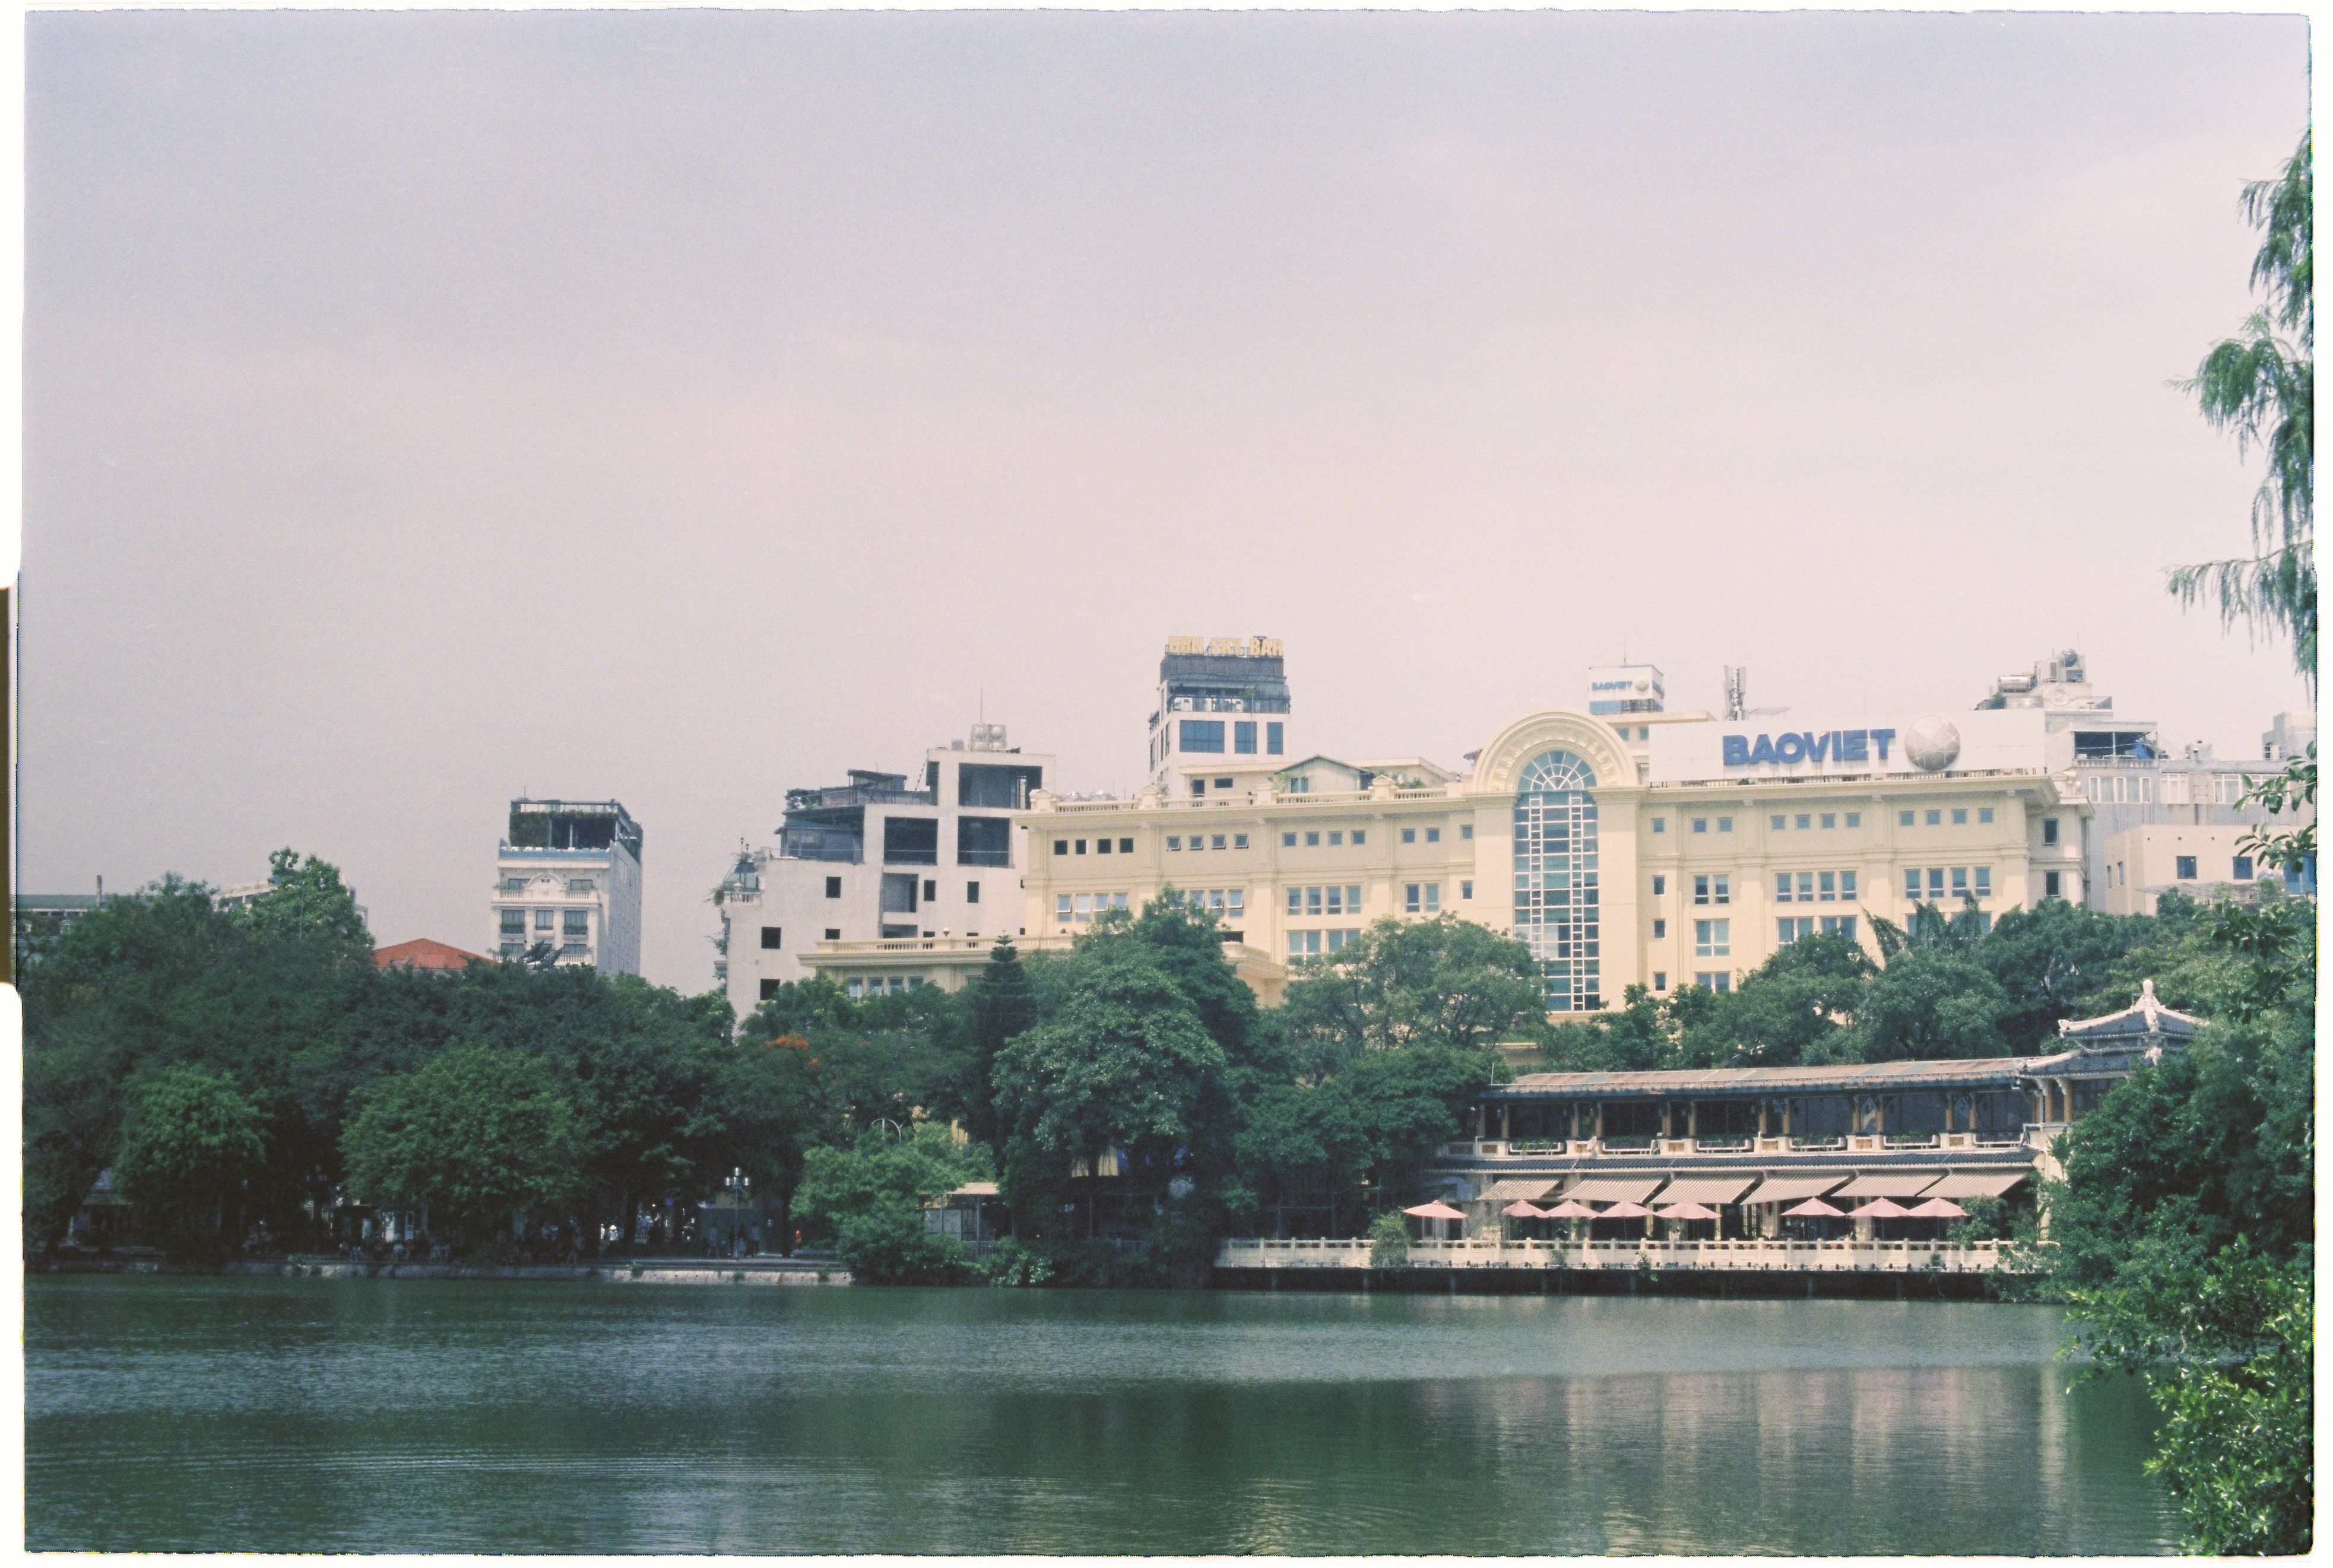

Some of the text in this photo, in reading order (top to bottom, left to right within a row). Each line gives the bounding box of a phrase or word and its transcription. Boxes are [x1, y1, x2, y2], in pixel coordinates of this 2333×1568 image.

[1209, 637, 1242, 655] SKY
[1249, 638, 1283, 656] BAR
[1592, 680, 1633, 691] BAOVIET
[1722, 728, 1895, 766] BAOVIET
